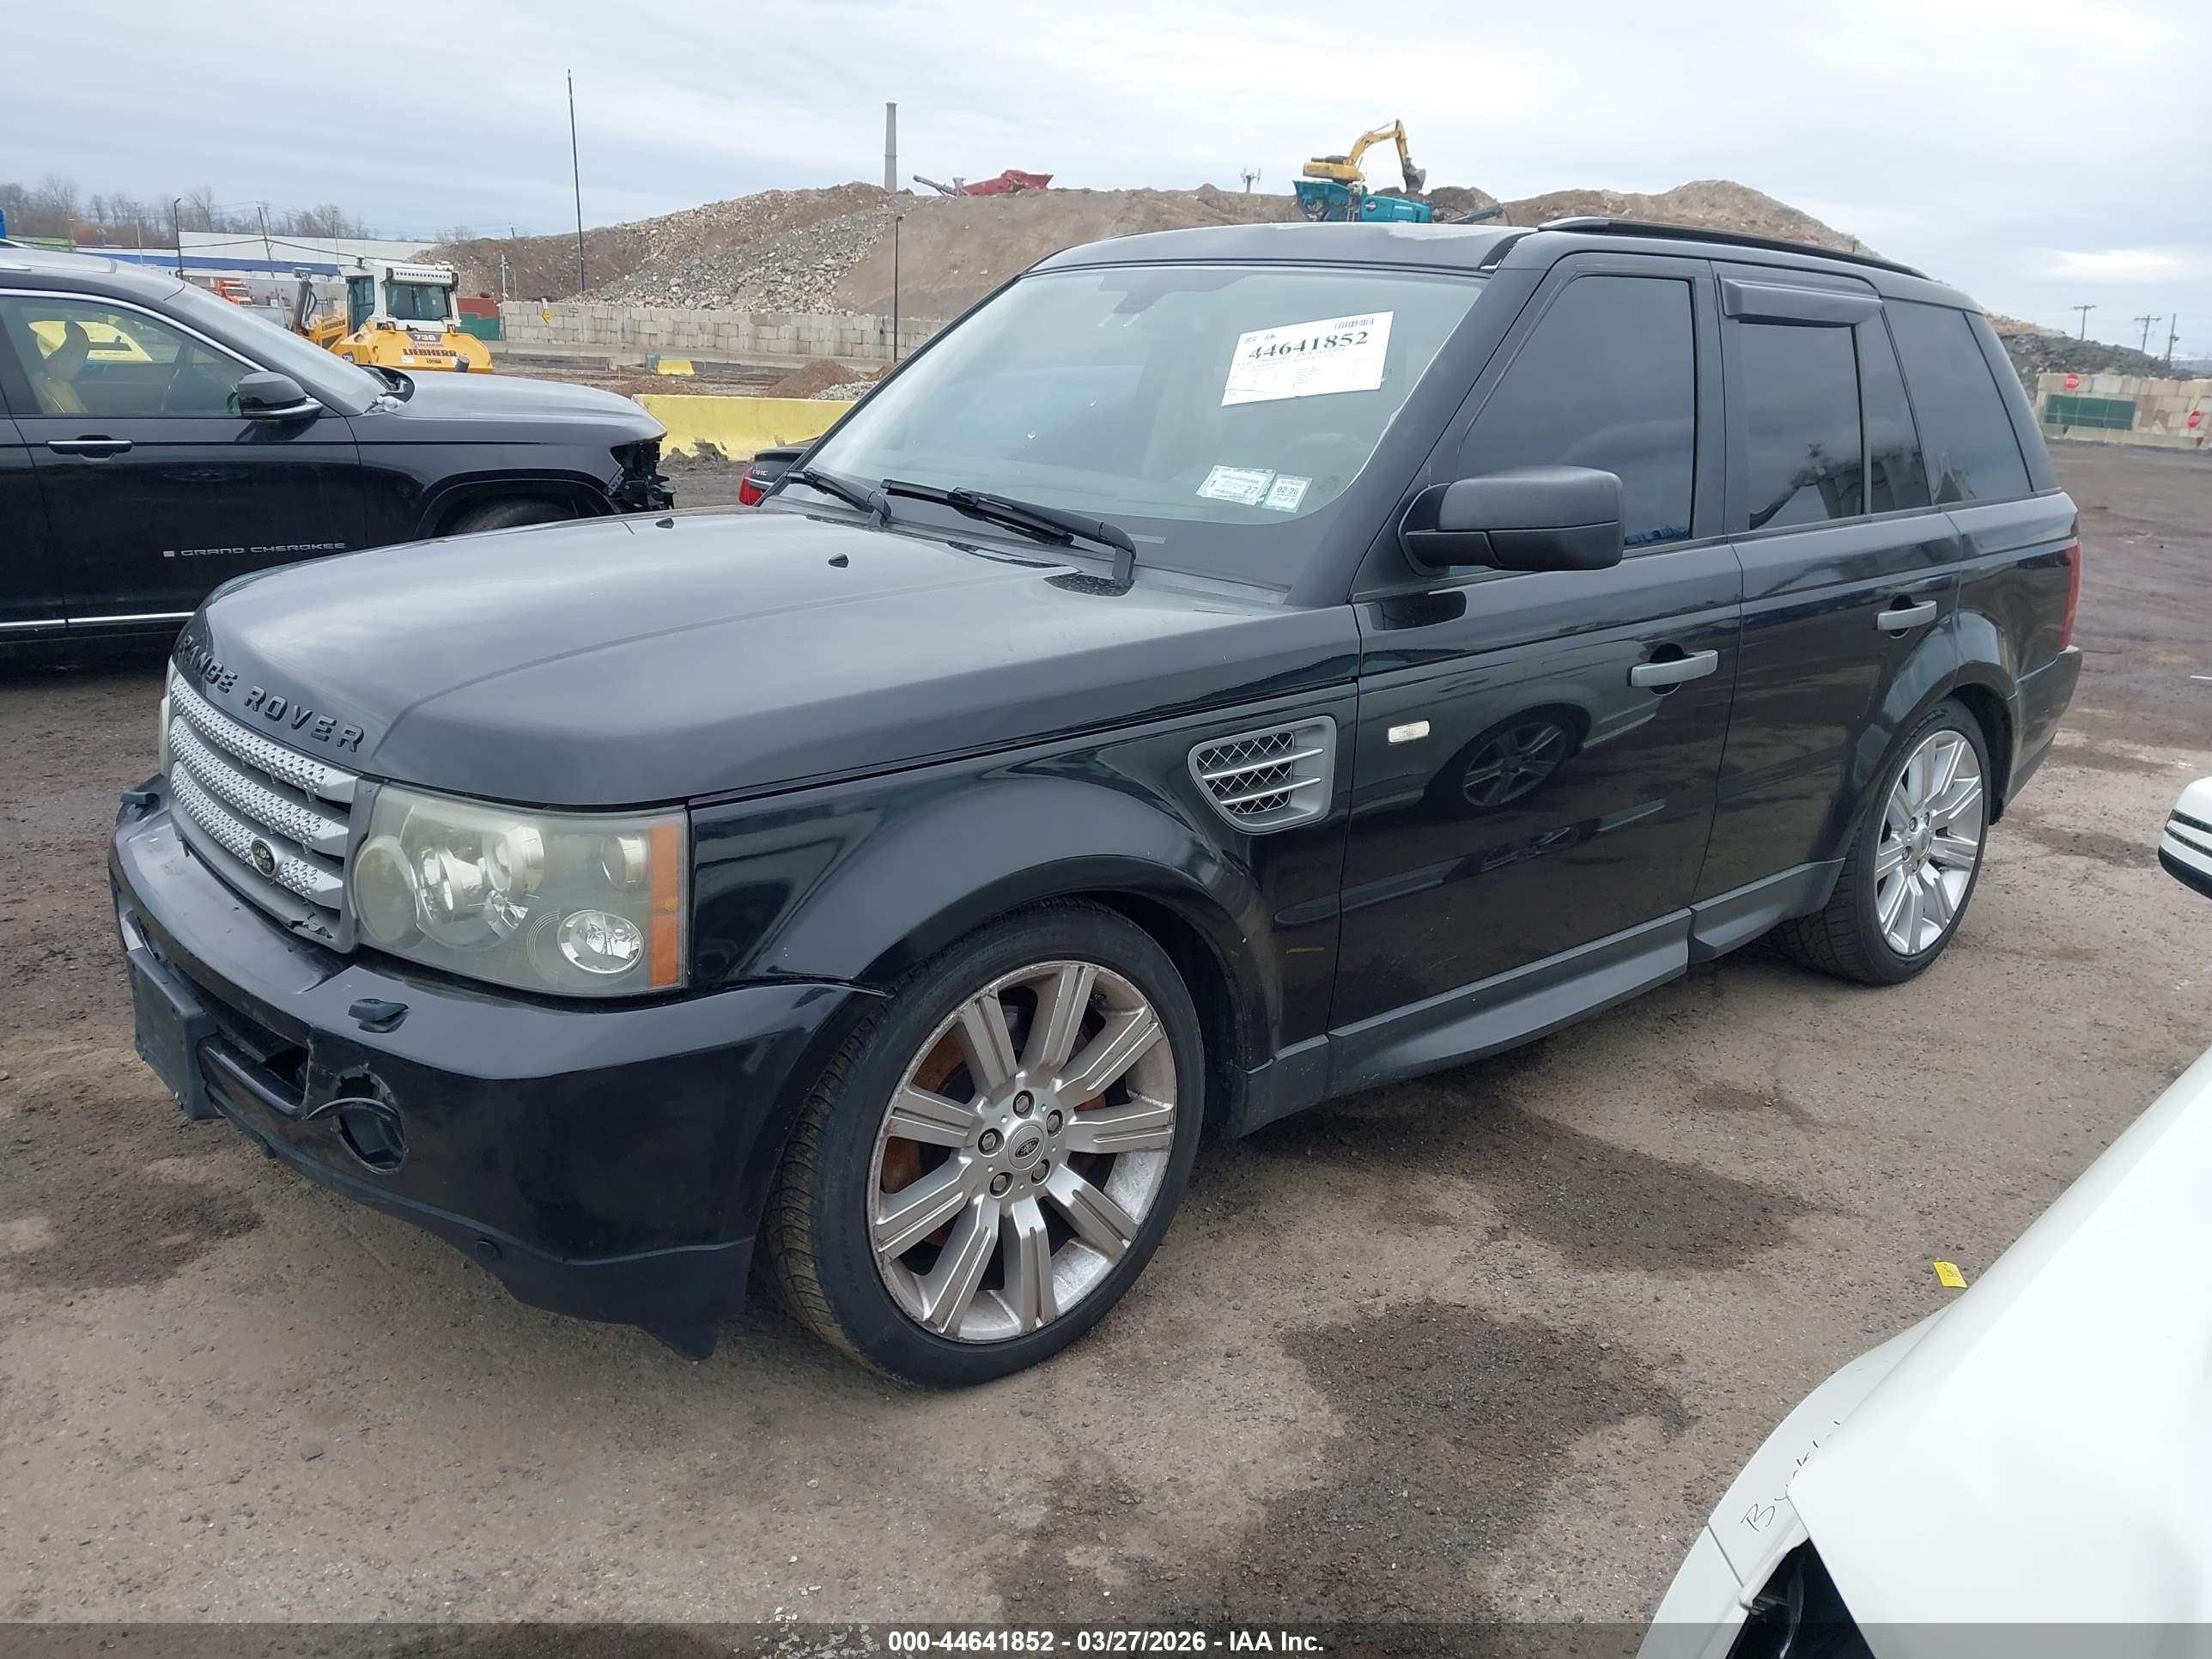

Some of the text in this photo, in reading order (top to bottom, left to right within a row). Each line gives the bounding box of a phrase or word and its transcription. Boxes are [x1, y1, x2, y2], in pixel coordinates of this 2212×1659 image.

[402, 348, 459, 357] LIEBHERR
[1249, 331, 1369, 360] 44641852
[179, 542, 347, 557] GRAND CHEROKEE
[179, 635, 365, 753] RANGE ROVER
